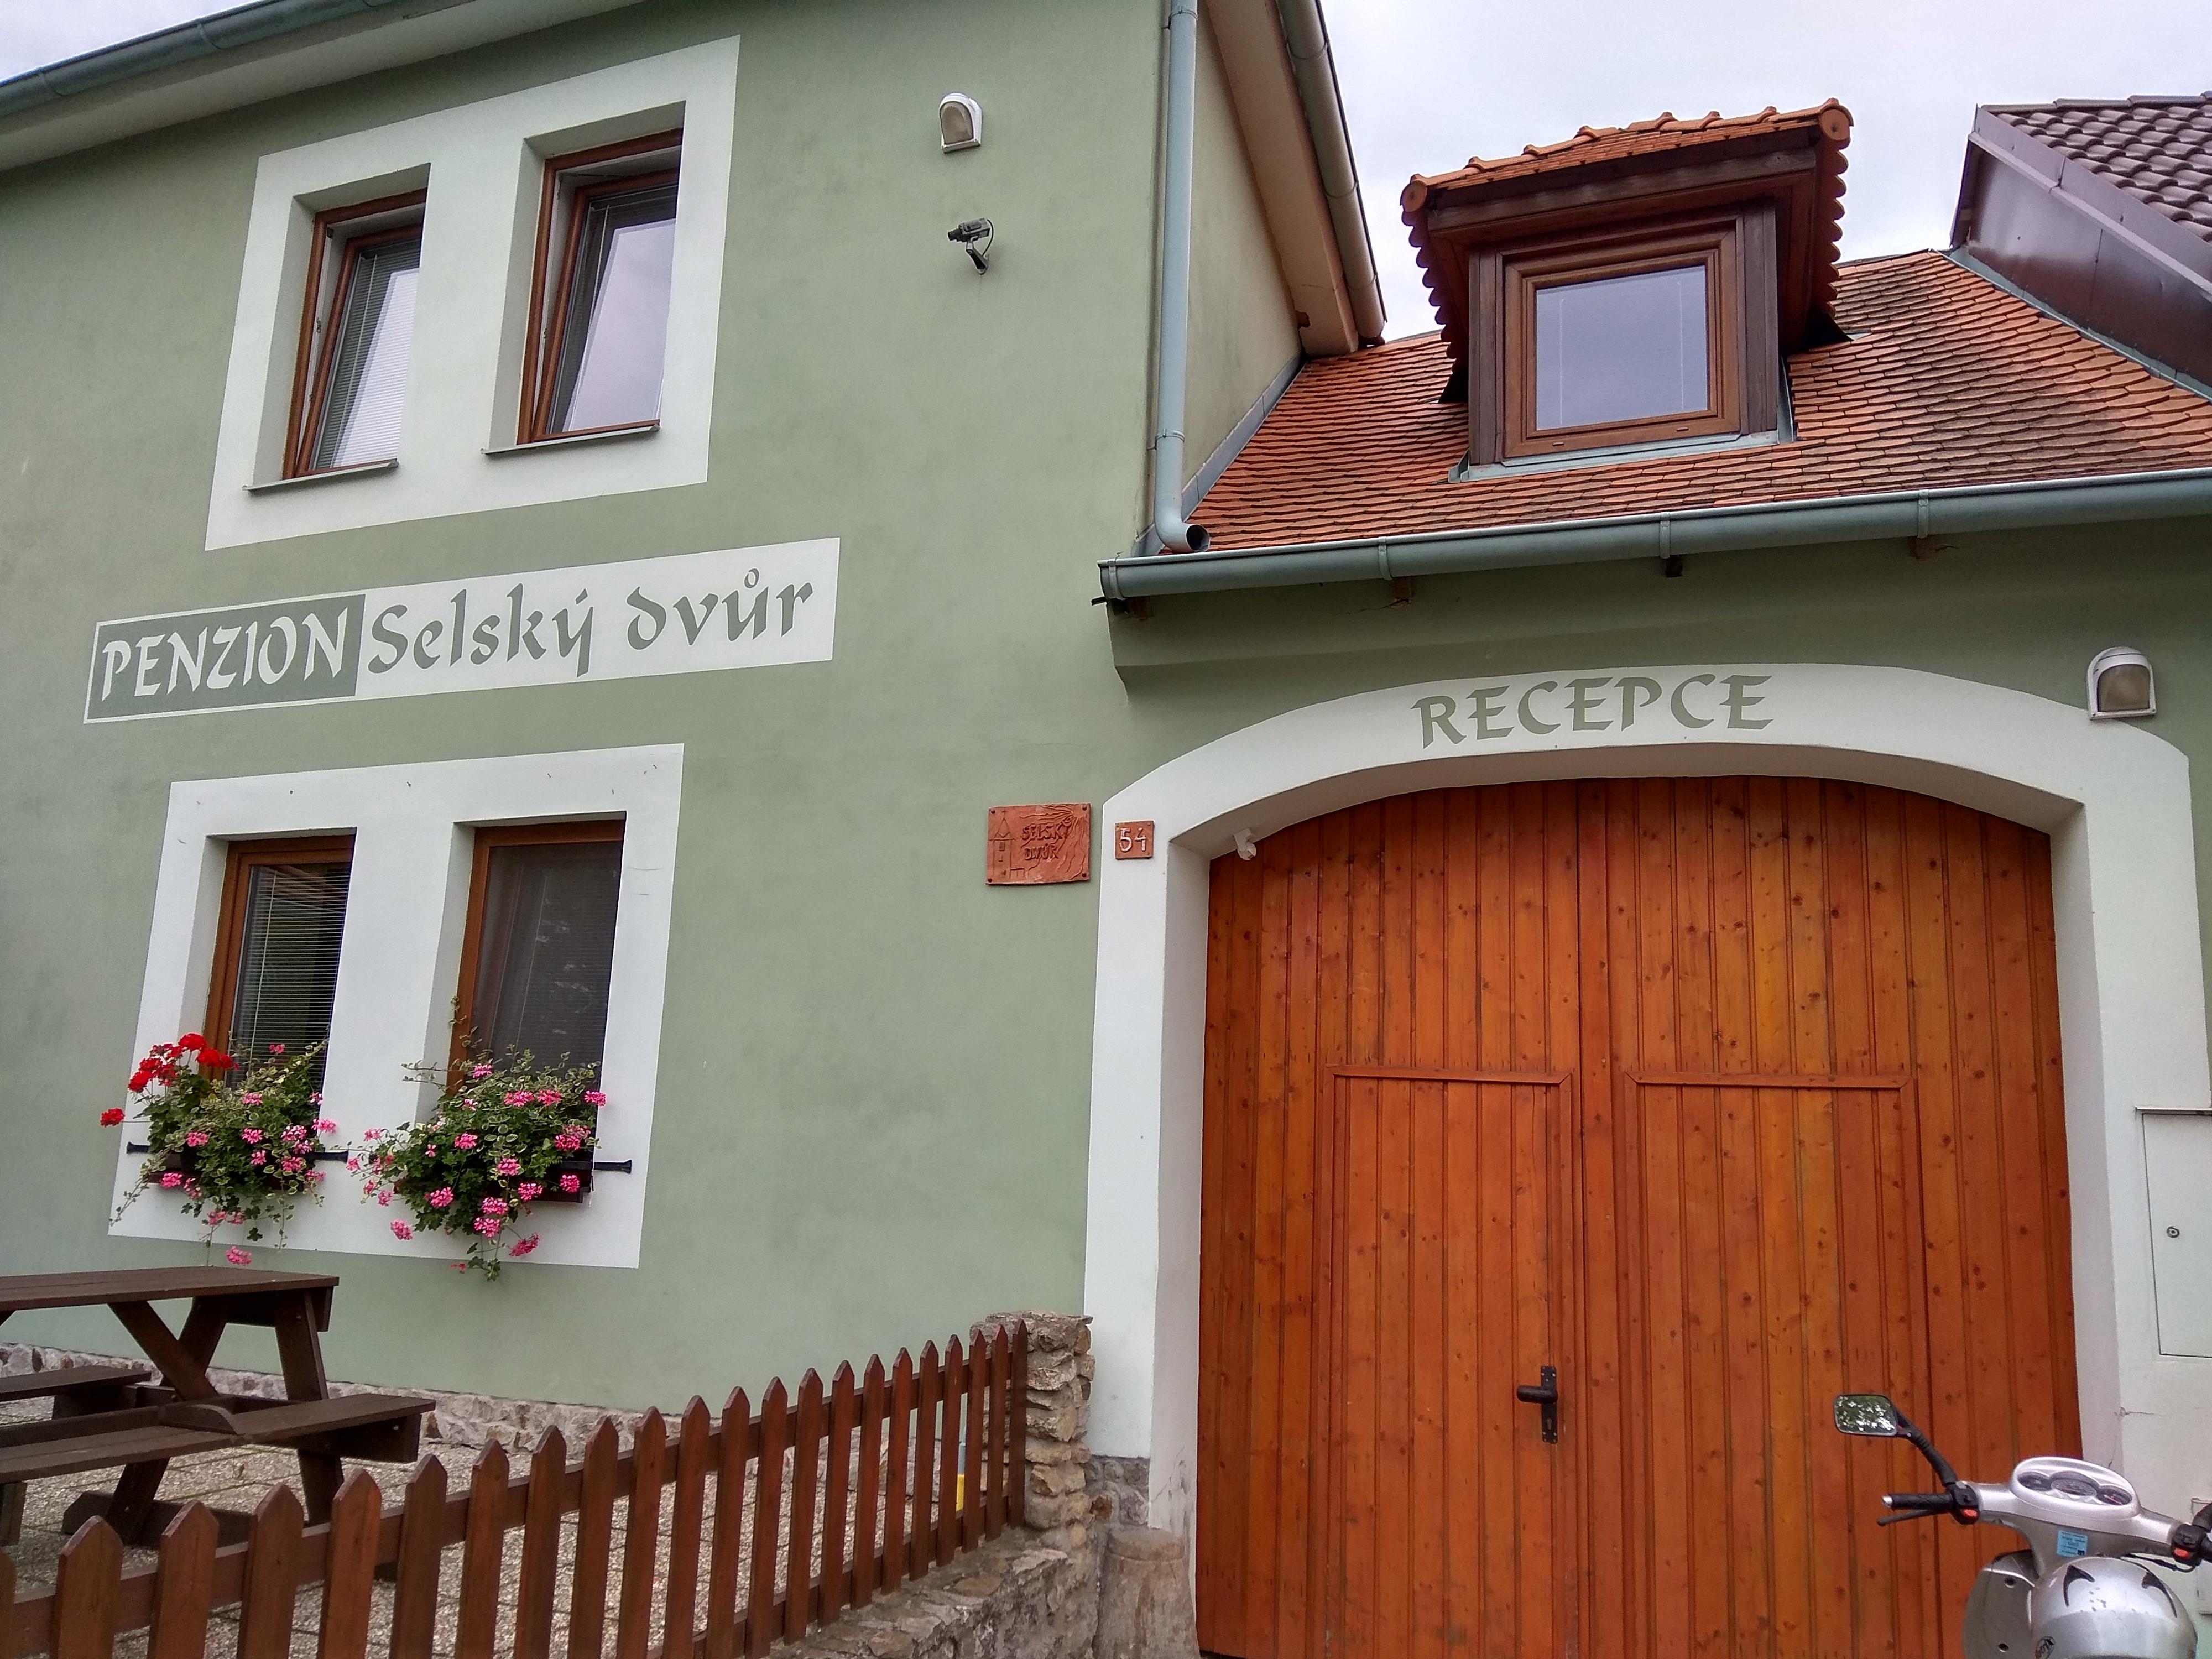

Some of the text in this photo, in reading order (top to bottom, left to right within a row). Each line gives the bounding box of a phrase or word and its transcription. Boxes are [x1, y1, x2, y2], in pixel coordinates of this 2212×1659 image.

[101, 567, 814, 702] PENZION Selský dvůr
[1410, 673, 1774, 749] RECEPCE
[1119, 827, 1147, 852] 54
